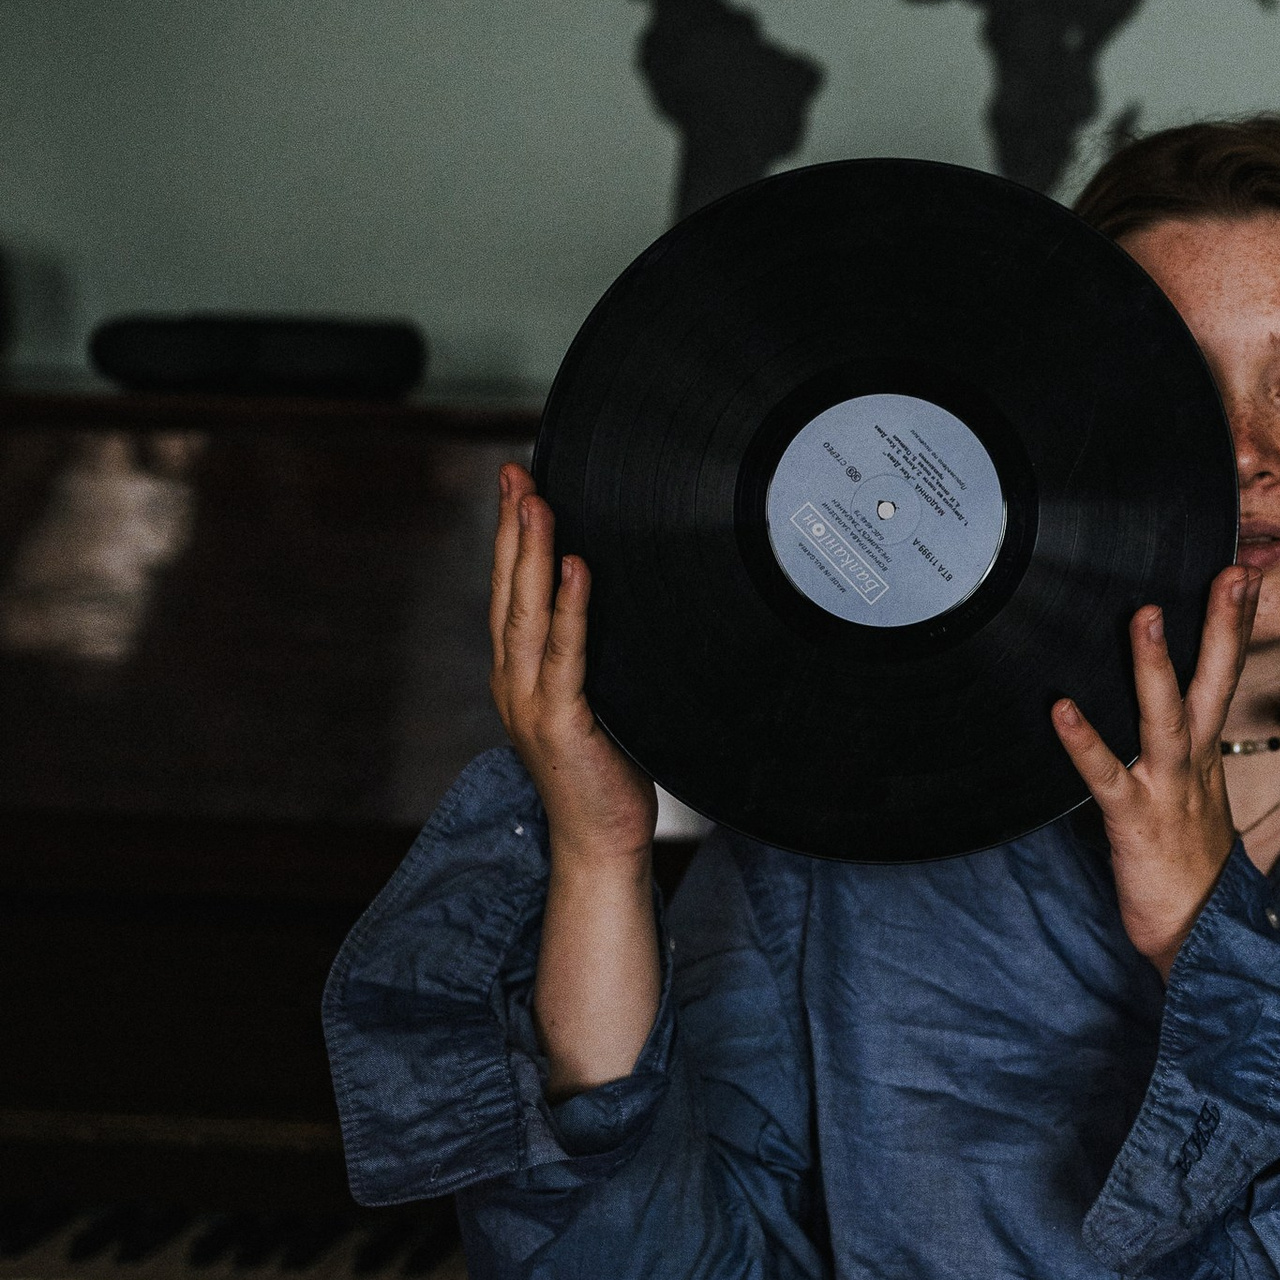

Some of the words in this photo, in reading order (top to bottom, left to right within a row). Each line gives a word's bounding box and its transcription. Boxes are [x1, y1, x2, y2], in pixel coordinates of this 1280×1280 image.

[874, 425, 888, 438] Дева
[886, 437, 896, 449] Как
[823, 442, 847, 466] СТЕРЕО
[915, 483, 945, 516] МАДОННА
[821, 502, 851, 532] ЗАПАЗЕНИ
[850, 531, 868, 550] ПРАВА
[798, 542, 825, 571] BULGARIA
[865, 549, 888, 572] ВСИЧКИ
[829, 577, 847, 593] MADE
